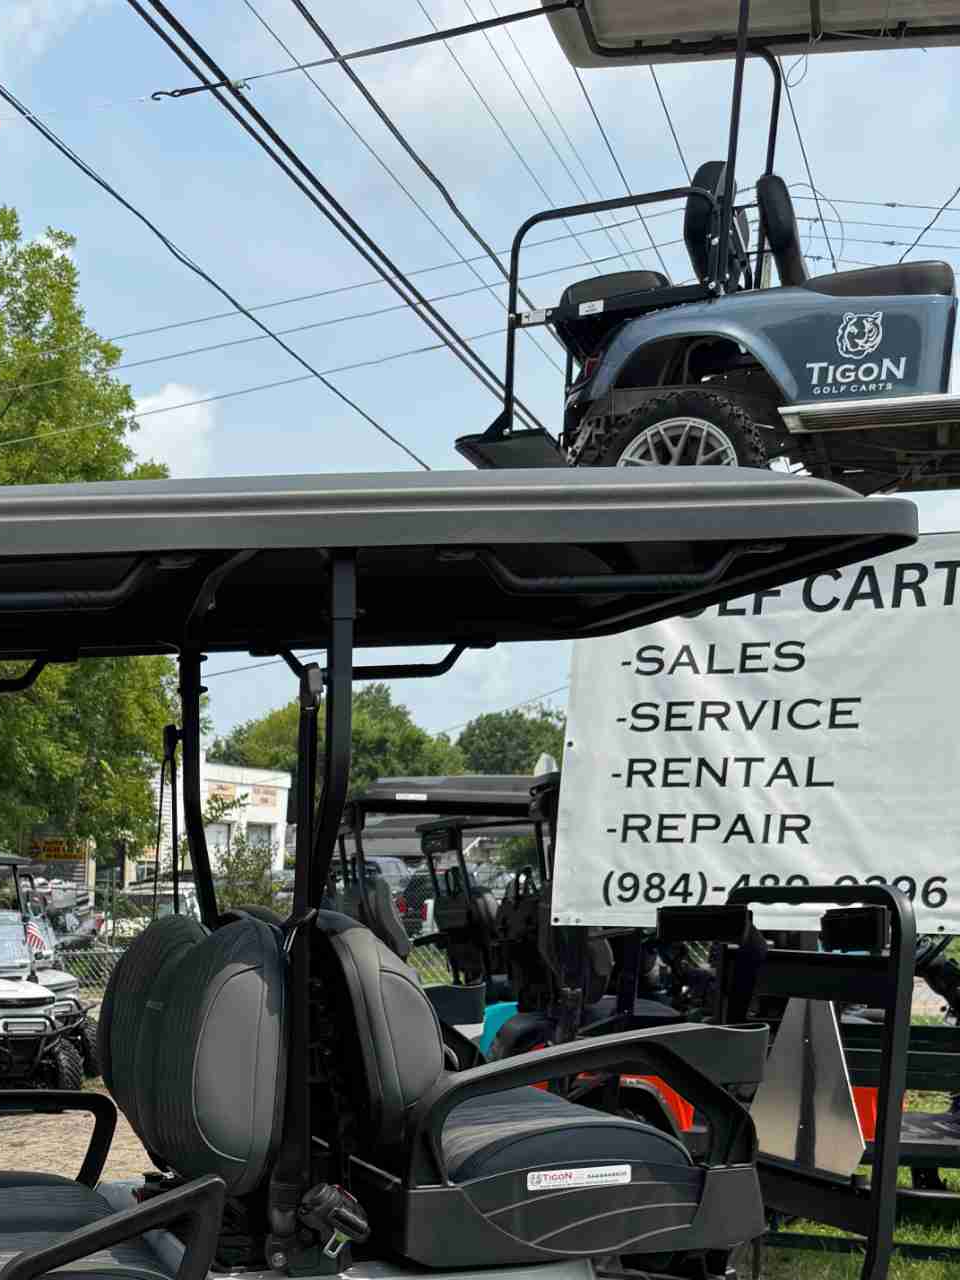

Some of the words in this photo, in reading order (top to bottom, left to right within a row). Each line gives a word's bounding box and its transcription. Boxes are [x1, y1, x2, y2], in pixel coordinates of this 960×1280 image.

[806, 357, 907, 385] TIGON
[812, 384, 847, 394] GOLF
[850, 382, 893, 393] CARTS
[621, 640, 806, 676] -SALES
[616, 697, 862, 732] -SERVICE
[611, 756, 835, 788] -RENTAL
[606, 813, 812, 844] -REPAIR
